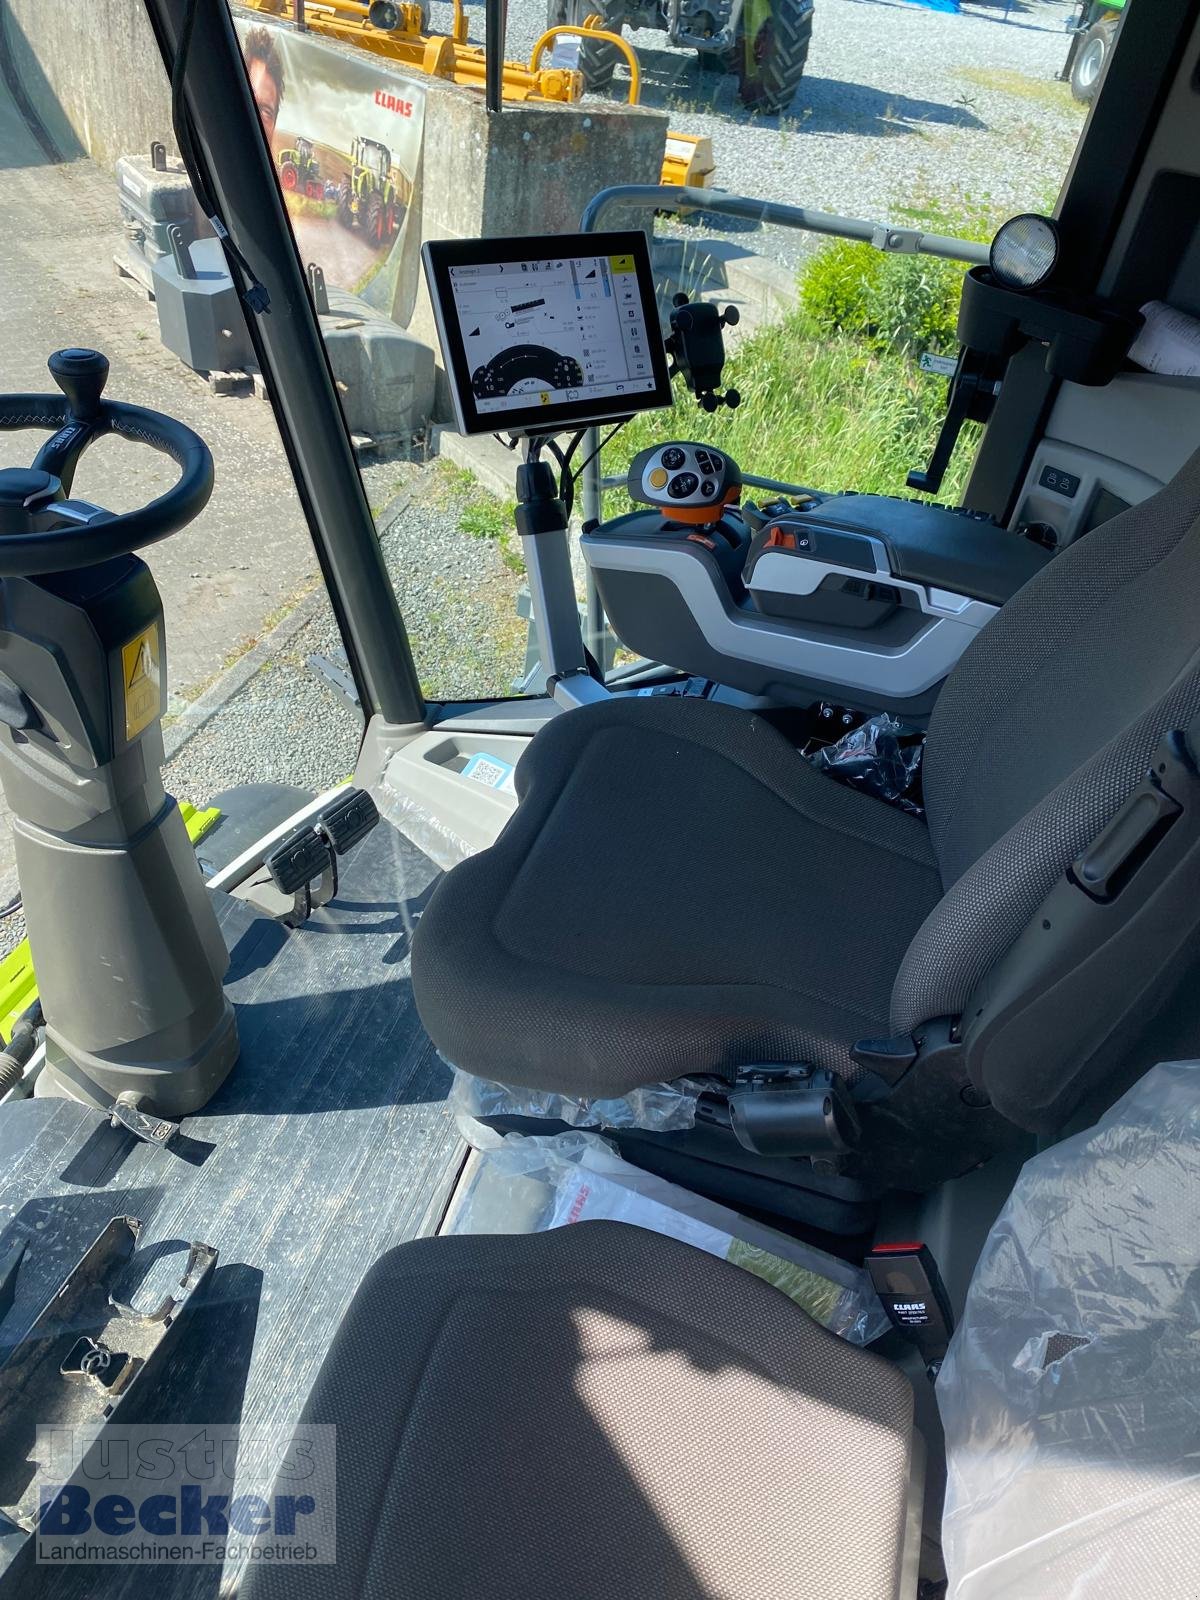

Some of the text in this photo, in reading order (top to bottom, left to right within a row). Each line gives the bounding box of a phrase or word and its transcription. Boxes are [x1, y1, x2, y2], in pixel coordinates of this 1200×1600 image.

[374, 89, 413, 118] CLAAS
[51, 427, 76, 449] CLAAS
[893, 1303, 926, 1311] CLAAS
